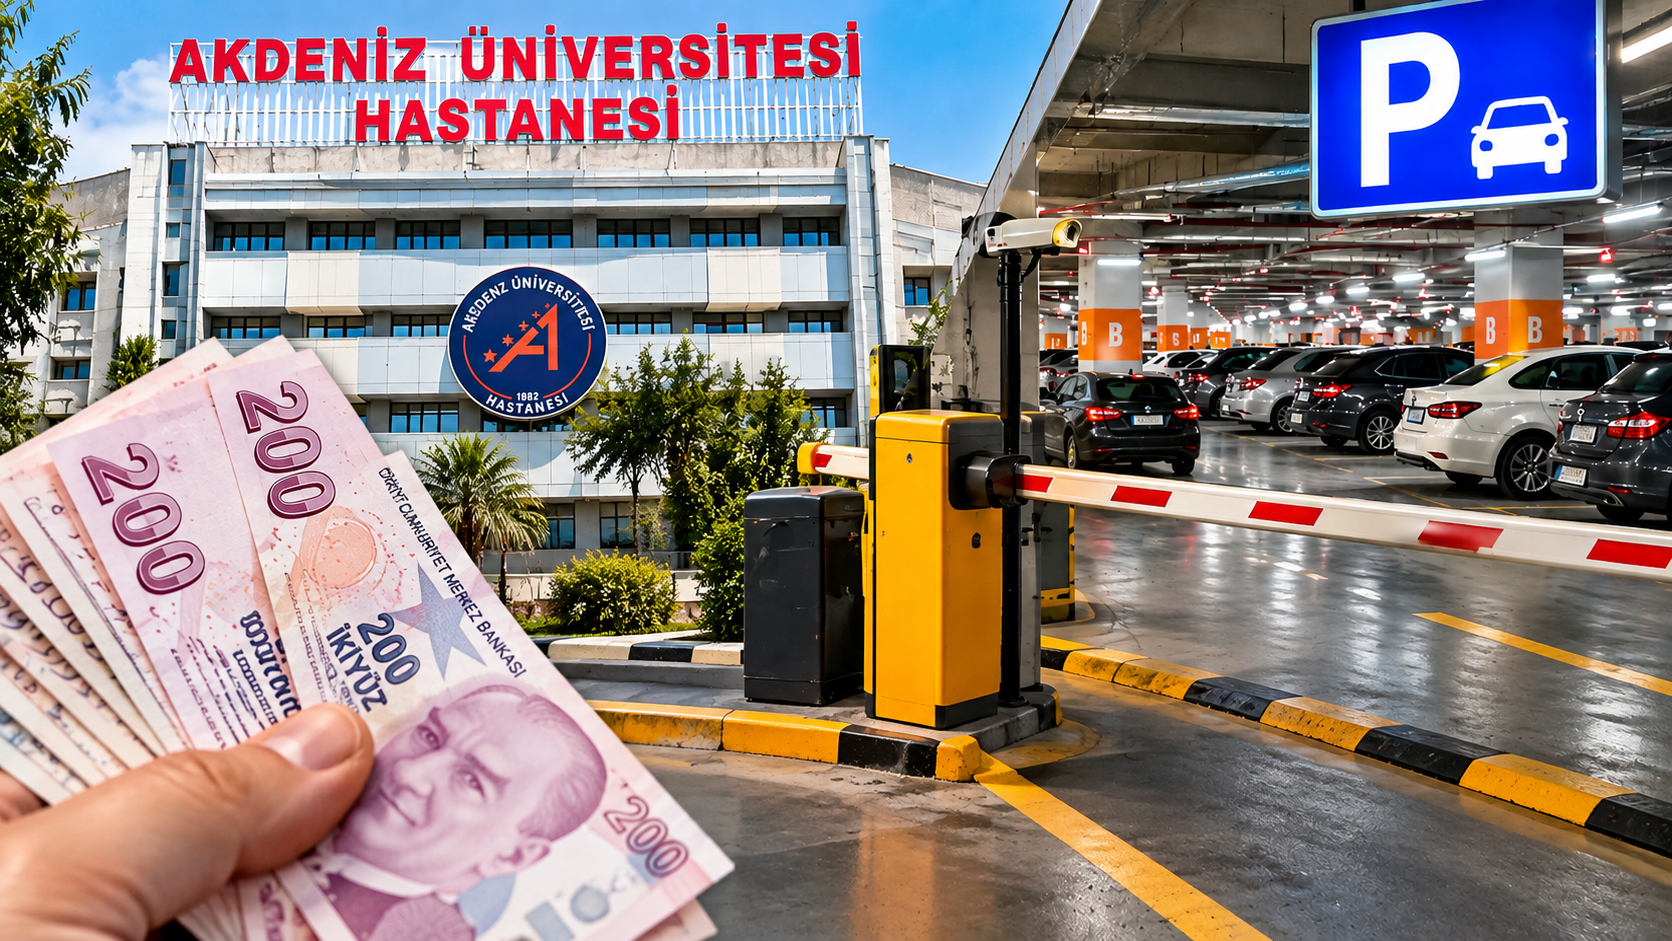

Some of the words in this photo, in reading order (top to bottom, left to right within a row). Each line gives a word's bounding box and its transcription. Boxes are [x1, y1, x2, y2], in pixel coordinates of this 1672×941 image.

[169, 26, 426, 83] AKDENİZ
[461, 21, 861, 80] ÜNİVERSİTESİ
[355, 84, 680, 142] HASTANESİ
[1360, 31, 1460, 188] P
[1108, 322, 1124, 347] B
[1485, 316, 1496, 345] B
[1527, 316, 1543, 343] B
[236, 381, 336, 519] 200
[81, 442, 206, 595] 200
[356, 612, 421, 685] 200
[476, 620, 527, 678] BANKASI
[603, 795, 689, 879] 200
